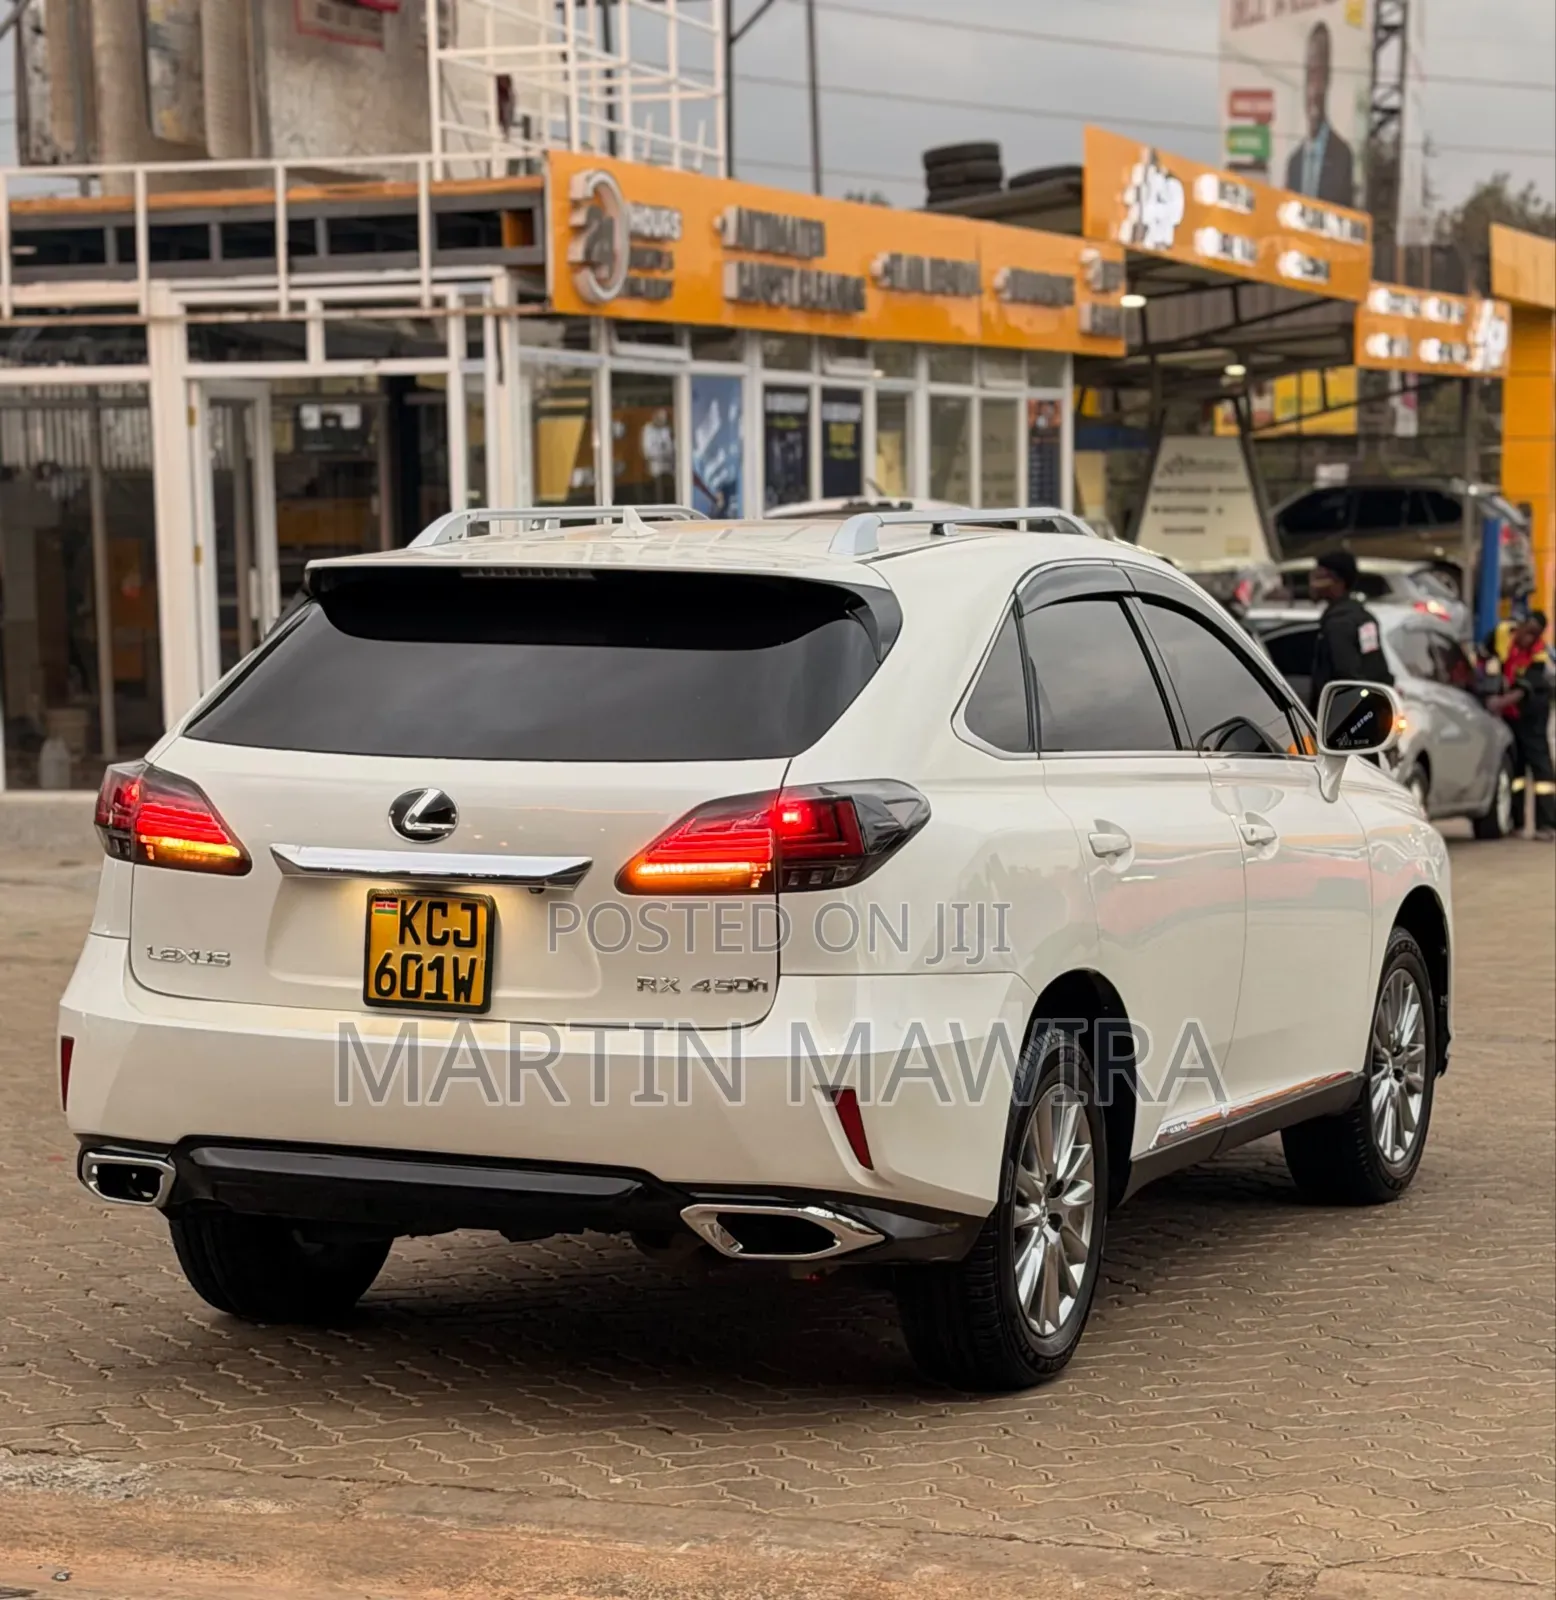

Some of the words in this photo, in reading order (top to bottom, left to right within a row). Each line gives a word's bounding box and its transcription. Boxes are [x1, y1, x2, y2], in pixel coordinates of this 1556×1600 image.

[398, 899, 478, 949] KCJ
[146, 945, 232, 968] LEXUS
[374, 952, 478, 1004] 601W
[636, 975, 681, 994] RX
[690, 976, 769, 994] 450h
